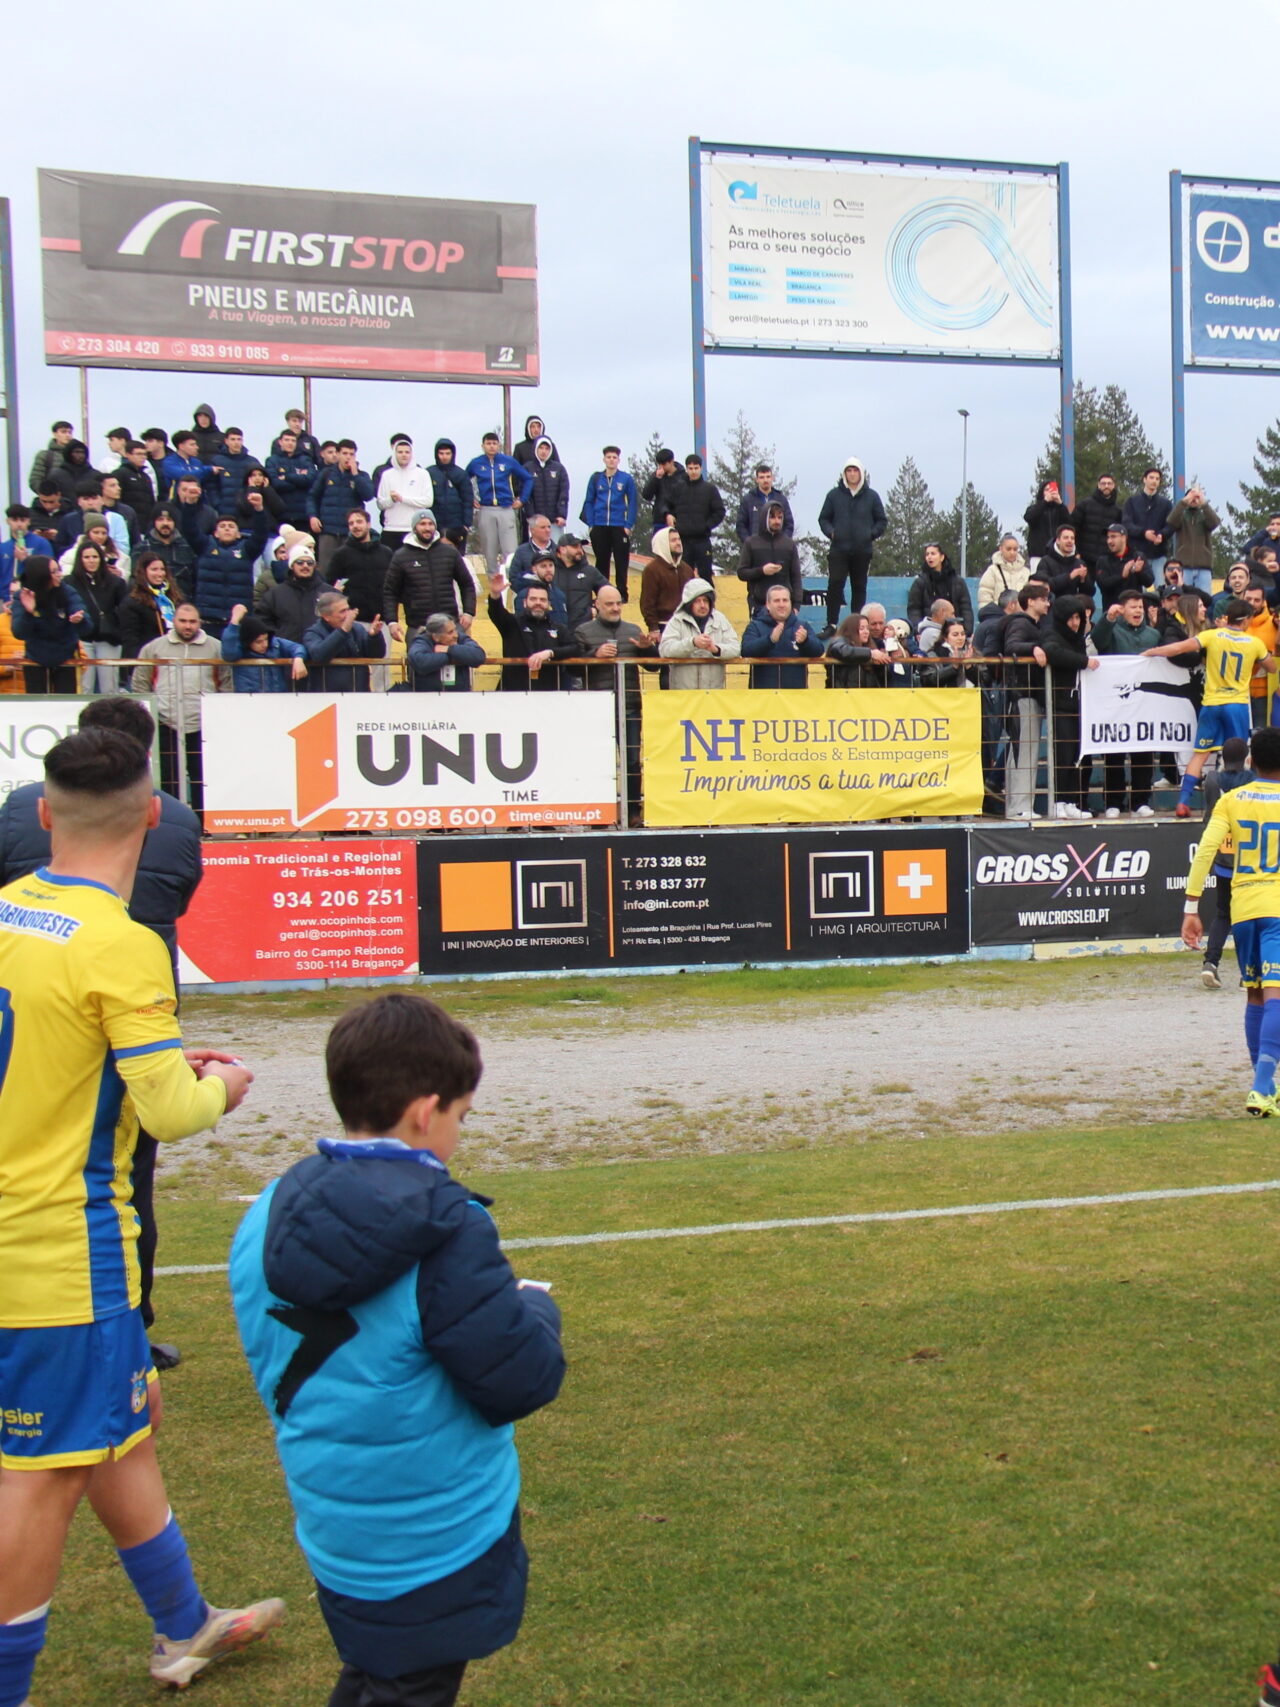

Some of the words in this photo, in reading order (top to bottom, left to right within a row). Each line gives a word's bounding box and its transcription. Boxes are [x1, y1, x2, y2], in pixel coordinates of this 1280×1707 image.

[763, 194, 820, 209] Teletuela
[729, 225, 743, 235] As
[748, 228, 806, 240] melhores
[811, 231, 865, 245] soluções
[729, 239, 758, 251] para
[763, 243, 770, 251] o
[776, 244, 797, 253] seu
[801, 245, 851, 257] negócio
[189, 285, 266, 310] PNEUS
[276, 290, 288, 311] E
[297, 288, 414, 317] MECÂNICA
[1205, 293, 1274, 308] Construção
[209, 309, 218, 320] A
[312, 317, 346, 326] nossa
[350, 318, 390, 329] Paixão
[729, 315, 809, 326] geral@teletuela.pt
[818, 319, 832, 327] 273
[852, 320, 868, 328] 300
[78, 339, 102, 352] 273
[107, 340, 130, 353] 304
[135, 342, 159, 354] 420
[191, 344, 214, 357] 933
[218, 345, 242, 359] 910
[246, 347, 269, 360] 085
[1220, 651, 1243, 683] 17
[357, 723, 385, 731] REDE
[389, 720, 456, 731] IMOBILIÁRIA
[1092, 723, 1129, 742] UNO
[1137, 722, 1153, 740] DI
[1161, 723, 1191, 741] NOI
[680, 719, 745, 762] NH
[752, 718, 949, 743] PUBLICIDADE
[357, 733, 538, 786] UNU
[753, 749, 827, 762] Bordados
[832, 749, 843, 761] &
[848, 748, 948, 763] Estampagens
[680, 768, 811, 800] Imprimimos
[819, 775, 834, 789] a
[838, 769, 873, 789] tua
[878, 764, 949, 788] marca!
[502, 790, 539, 801] TIME
[214, 817, 285, 827] www.unu.pt
[347, 810, 388, 828] 273
[396, 810, 442, 826] 098
[449, 808, 496, 826] 600
[510, 809, 601, 823] time@unu.pt
[254, 853, 328, 864] Tradicional
[345, 852, 401, 864] Regional
[622, 858, 632, 868] T.
[636, 858, 657, 867] 273
[661, 857, 681, 867] 328
[685, 856, 706, 866] 632
[281, 868, 296, 877] de
[301, 866, 401, 876] Trás-os-Montes
[622, 880, 632, 890] T.
[636, 879, 657, 890] 918
[660, 879, 681, 889] 837
[685, 878, 706, 888] 377
[1067, 884, 1145, 898] SOLUTIONS
[273, 892, 312, 908] 934
[321, 890, 359, 906] 206
[367, 889, 403, 905] 251
[624, 899, 709, 911] info@ini.com.pt
[291, 915, 403, 926] www.ocopinhos.com
[1018, 909, 1110, 926] WWW.CROSSLED.PT
[280, 927, 403, 941] geral@ocopinhos.com
[670, 924, 700, 933] Braguinha
[819, 925, 845, 935] HMG
[856, 922, 940, 933] ARQUITECTURA
[448, 941, 459, 949] INI
[467, 938, 513, 949] INOVAÇÃO
[530, 936, 584, 945] INTERIORES
[256, 949, 290, 959] Bairro
[294, 949, 307, 958] do
[312, 947, 350, 959] Campo
[355, 946, 403, 955] Redondo
[297, 960, 347, 970] 5300-114
[352, 959, 403, 969] Bragança
